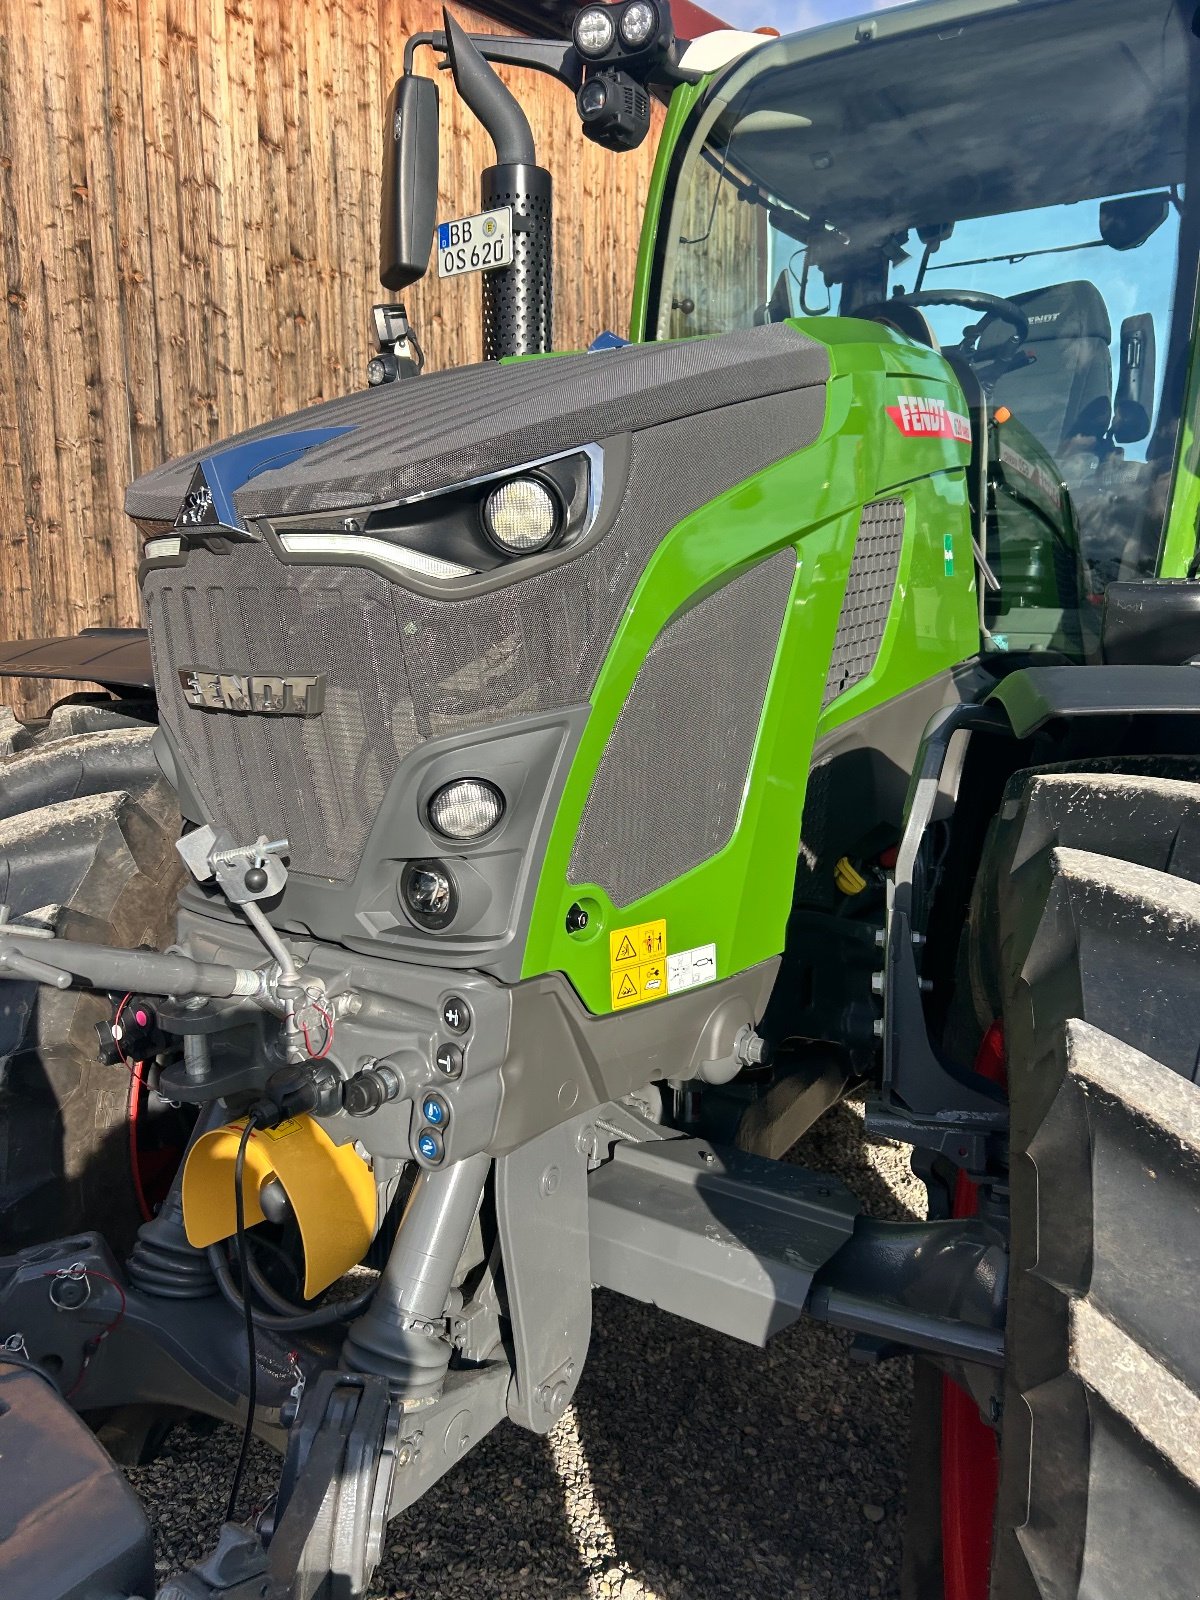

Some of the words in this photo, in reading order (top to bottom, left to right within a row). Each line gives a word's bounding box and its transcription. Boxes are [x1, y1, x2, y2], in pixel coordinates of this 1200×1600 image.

[450, 221, 472, 246] BB
[444, 248, 466, 272] OS
[471, 240, 504, 266] 620
[1028, 312, 1060, 324] ENDT
[897, 396, 945, 432] FENDT
[178, 668, 318, 713] FENDT
